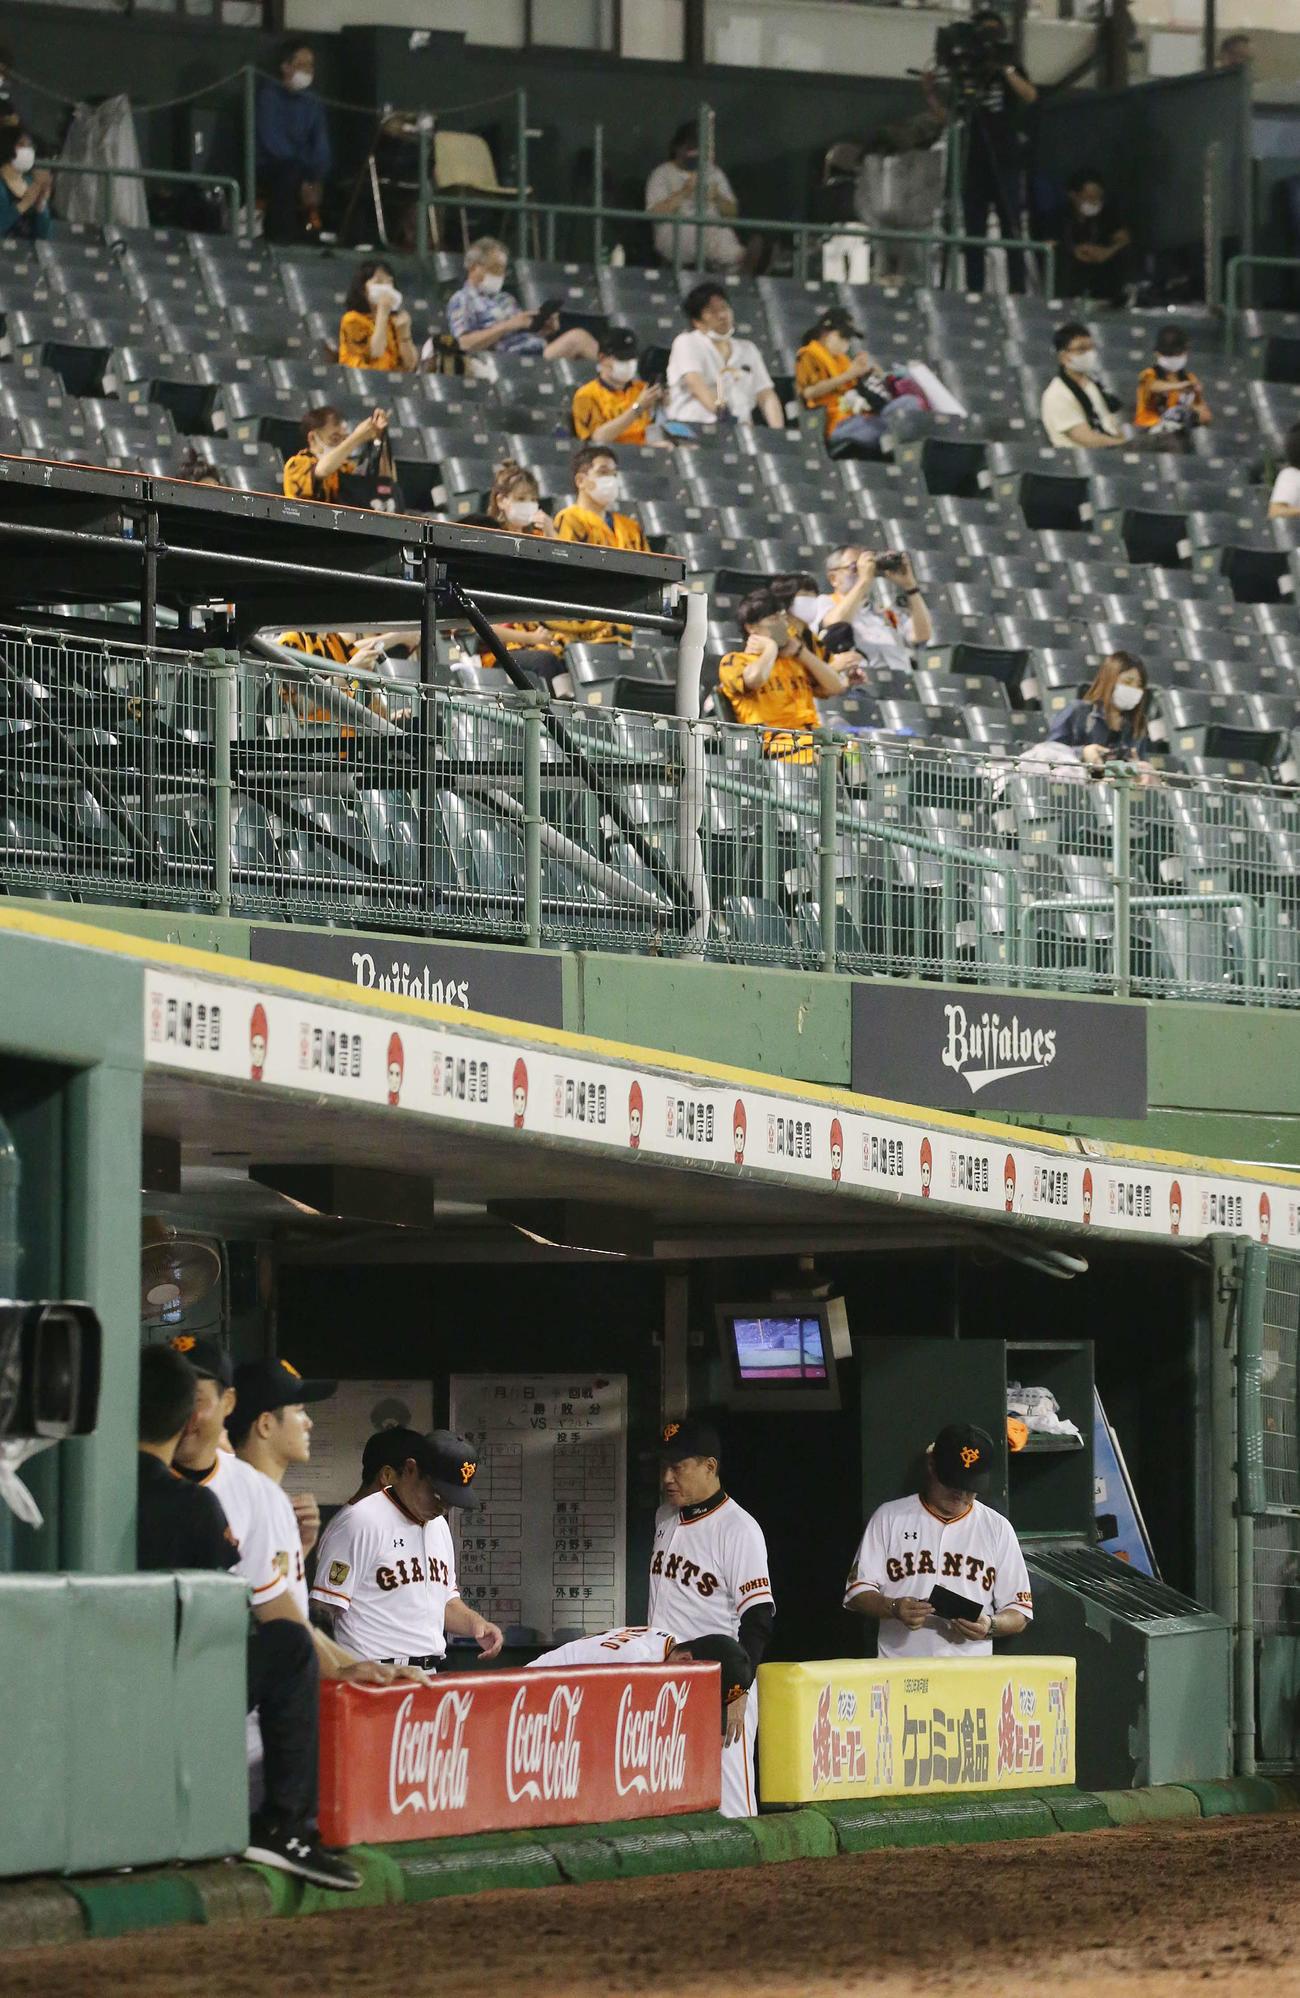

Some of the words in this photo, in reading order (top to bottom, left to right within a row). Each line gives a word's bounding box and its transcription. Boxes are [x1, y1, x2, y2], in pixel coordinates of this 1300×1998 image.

[941, 1004, 1057, 1073] Buffaloes
[530, 1418, 547, 1430] VS
[650, 1550, 720, 1597] ANTS
[886, 1550, 996, 1592] GIANTS
[902, 1704, 989, 1787] ケンミン食品
